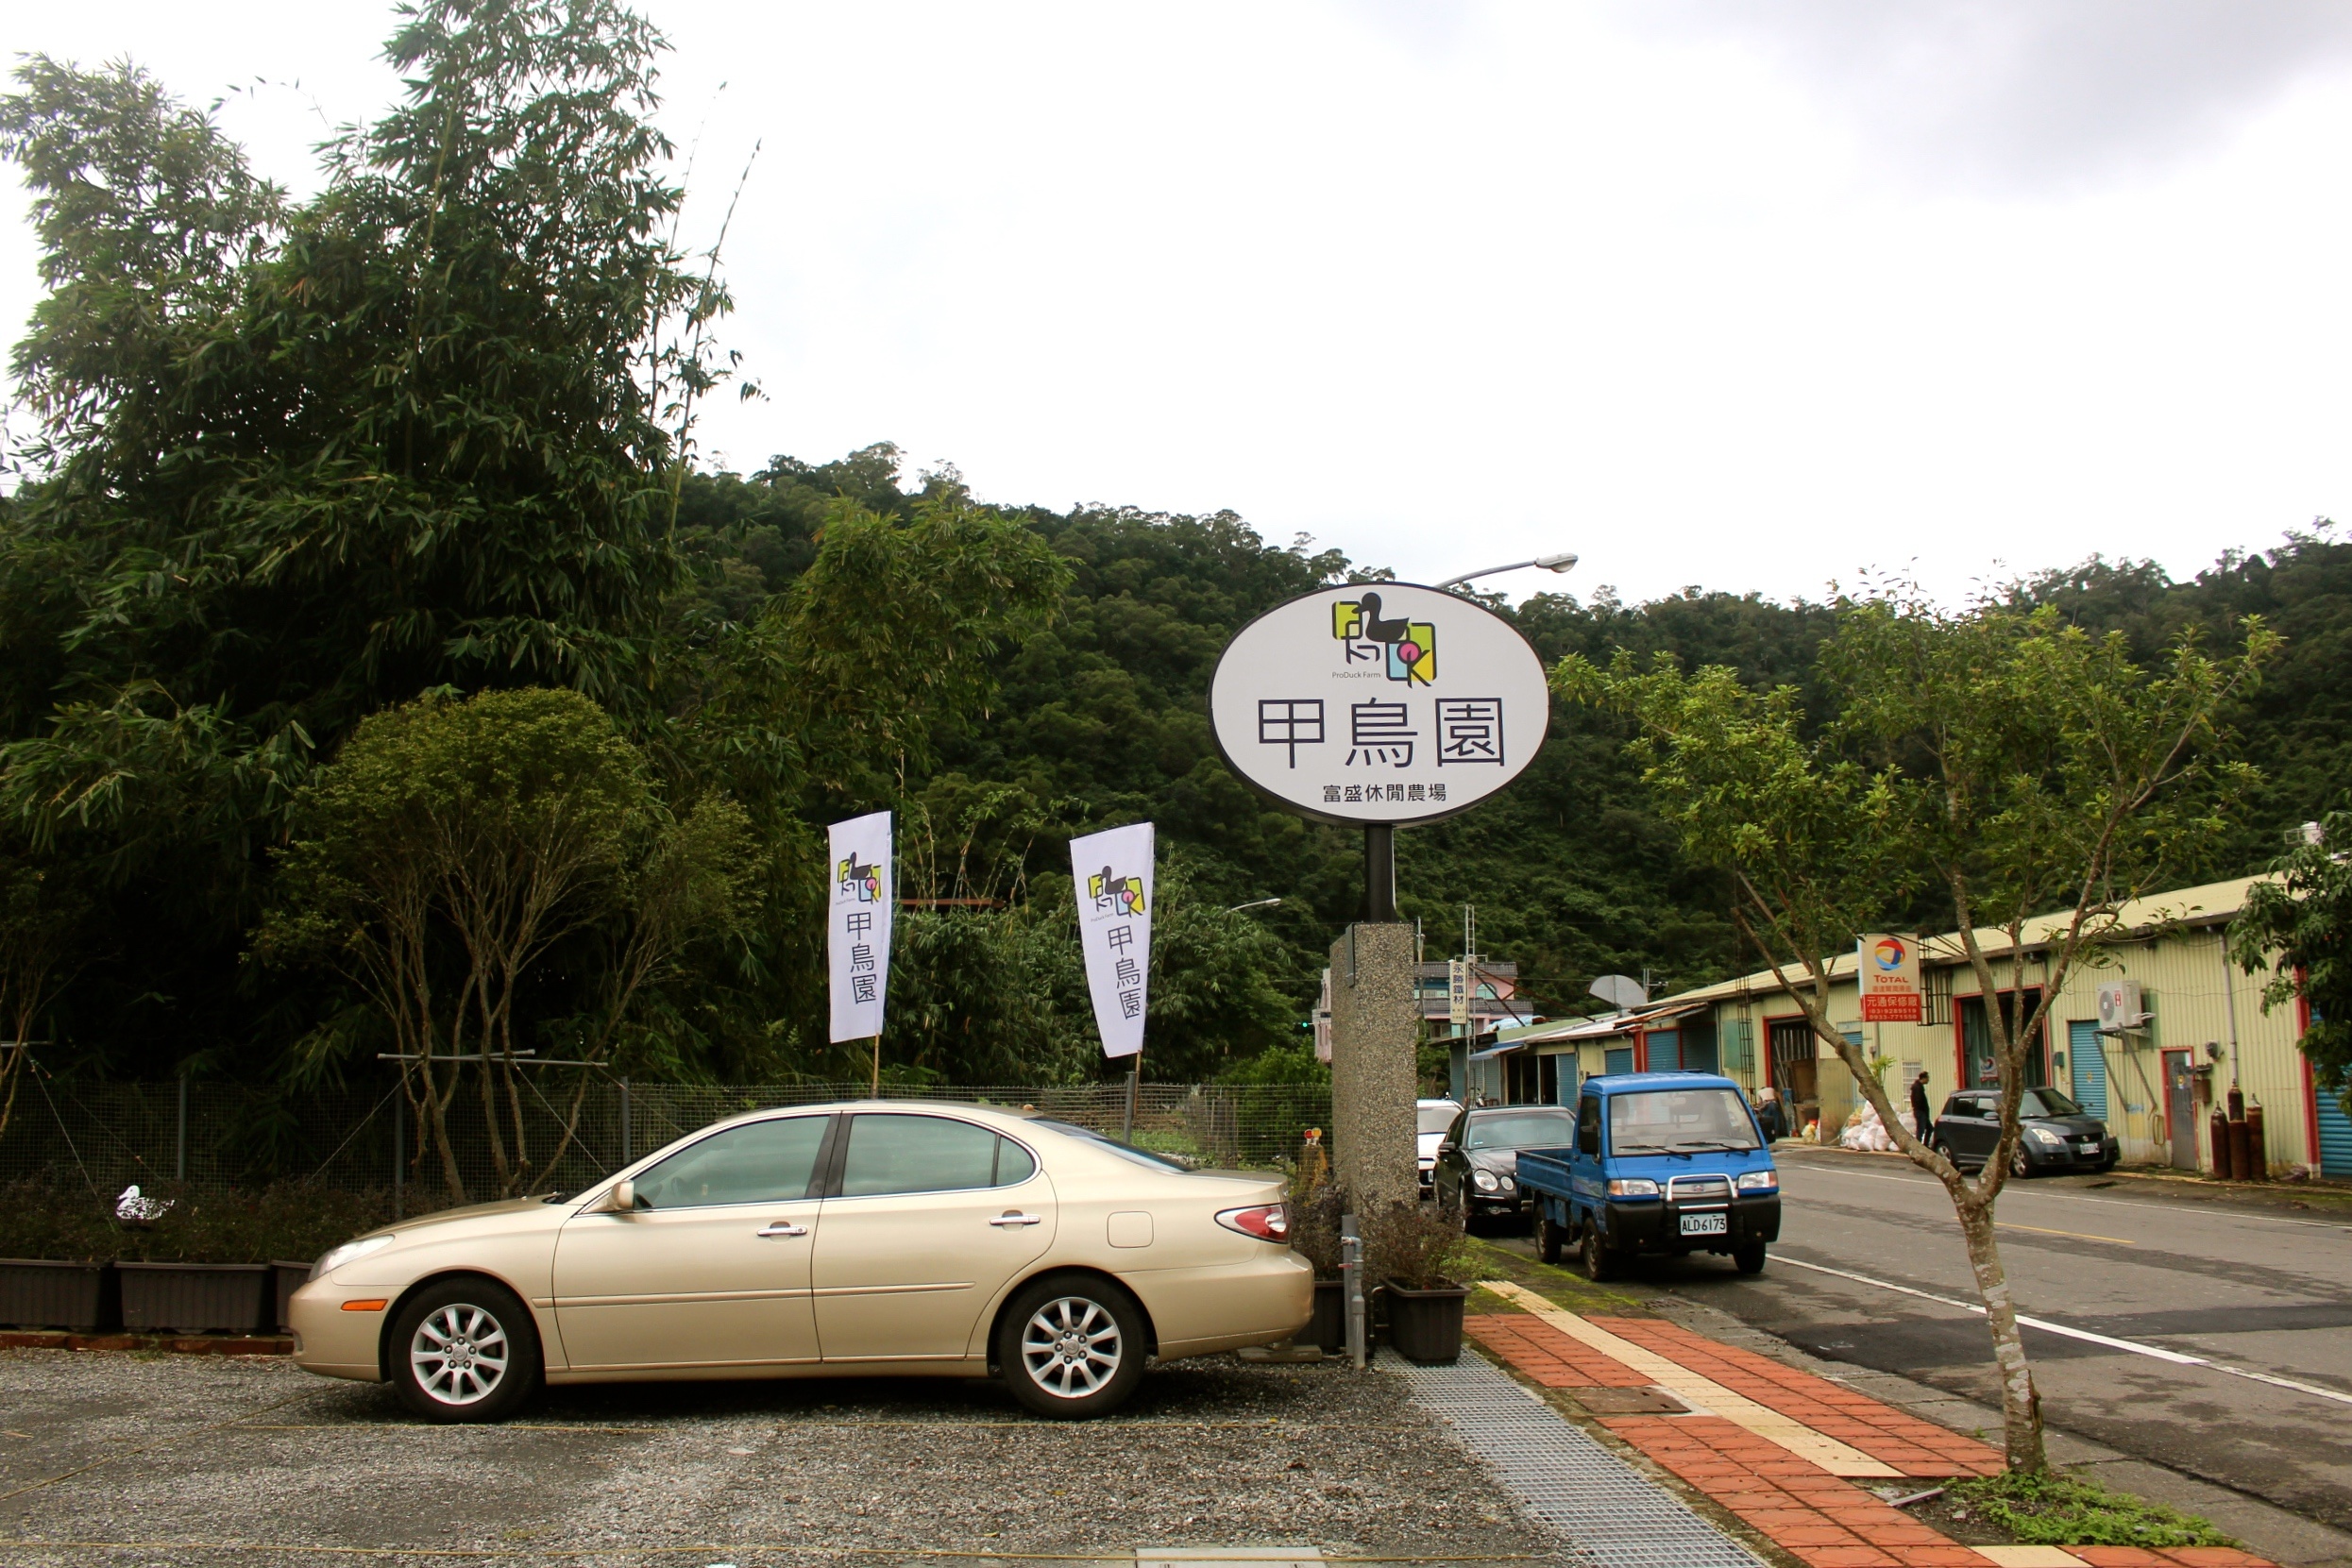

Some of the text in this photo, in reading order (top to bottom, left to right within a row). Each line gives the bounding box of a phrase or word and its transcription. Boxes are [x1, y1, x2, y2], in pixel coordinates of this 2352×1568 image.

[1258, 697, 1505, 769] 甲鳥園
[846, 911, 877, 1004] 甲鳥園
[1108, 924, 1142, 1020] 甲鳥園
[1873, 974, 1908, 983] TOTAL
[1867, 996, 1918, 1006] 元通保修廠
